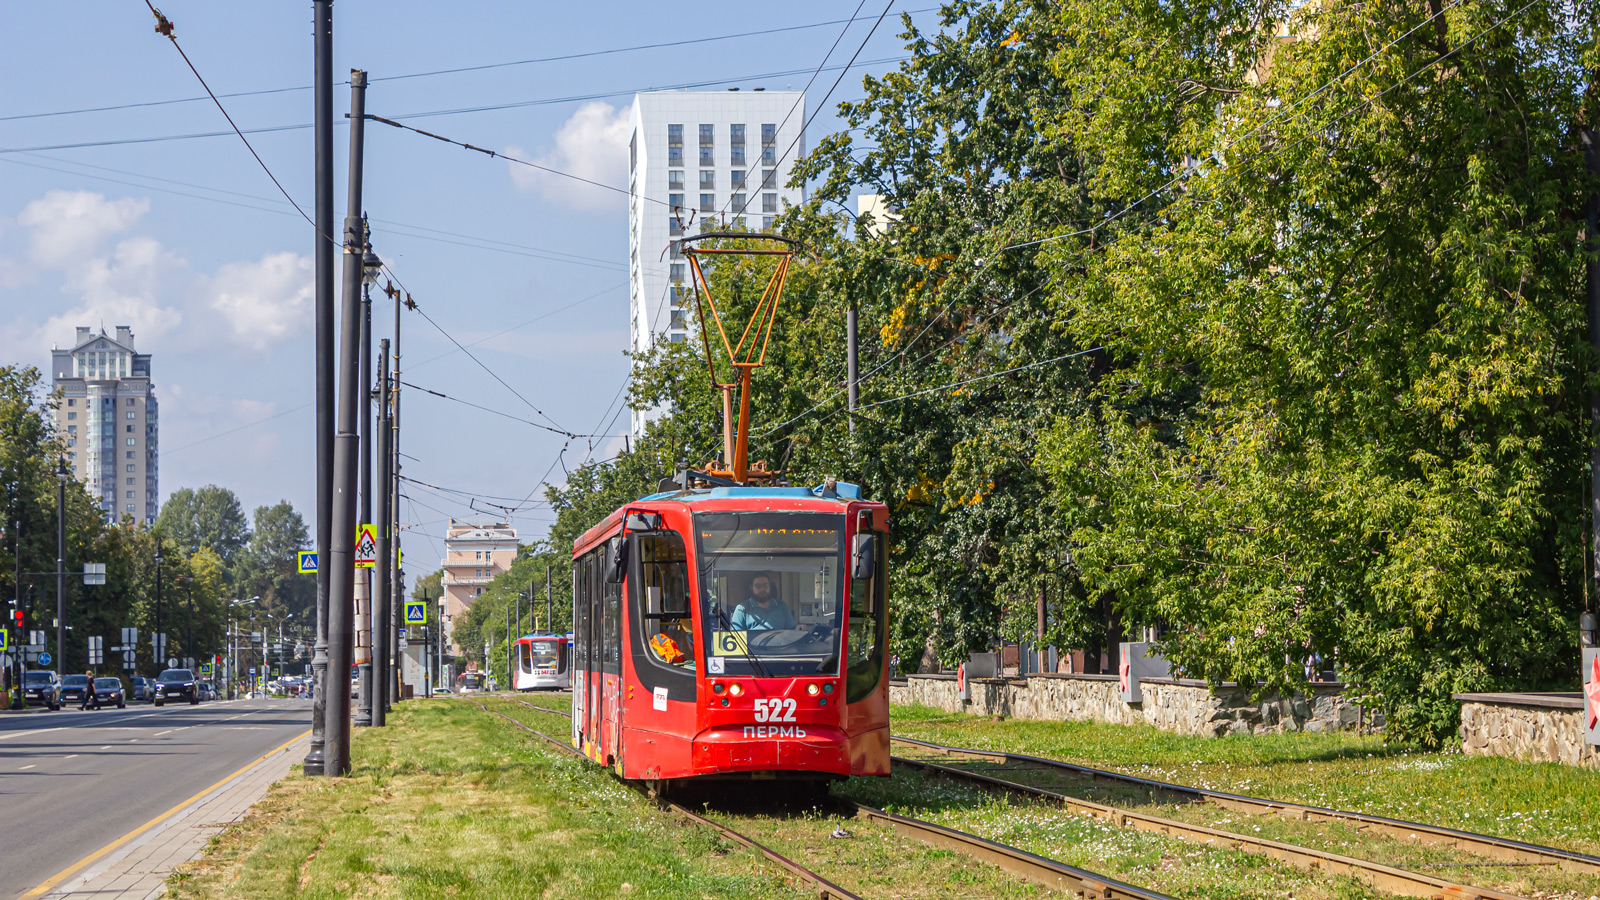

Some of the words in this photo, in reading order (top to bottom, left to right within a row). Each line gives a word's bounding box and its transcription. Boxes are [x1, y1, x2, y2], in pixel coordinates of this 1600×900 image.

[722, 635, 737, 652] 6
[754, 698, 797, 722] 522
[743, 726, 806, 738] ПЕРМЬ
